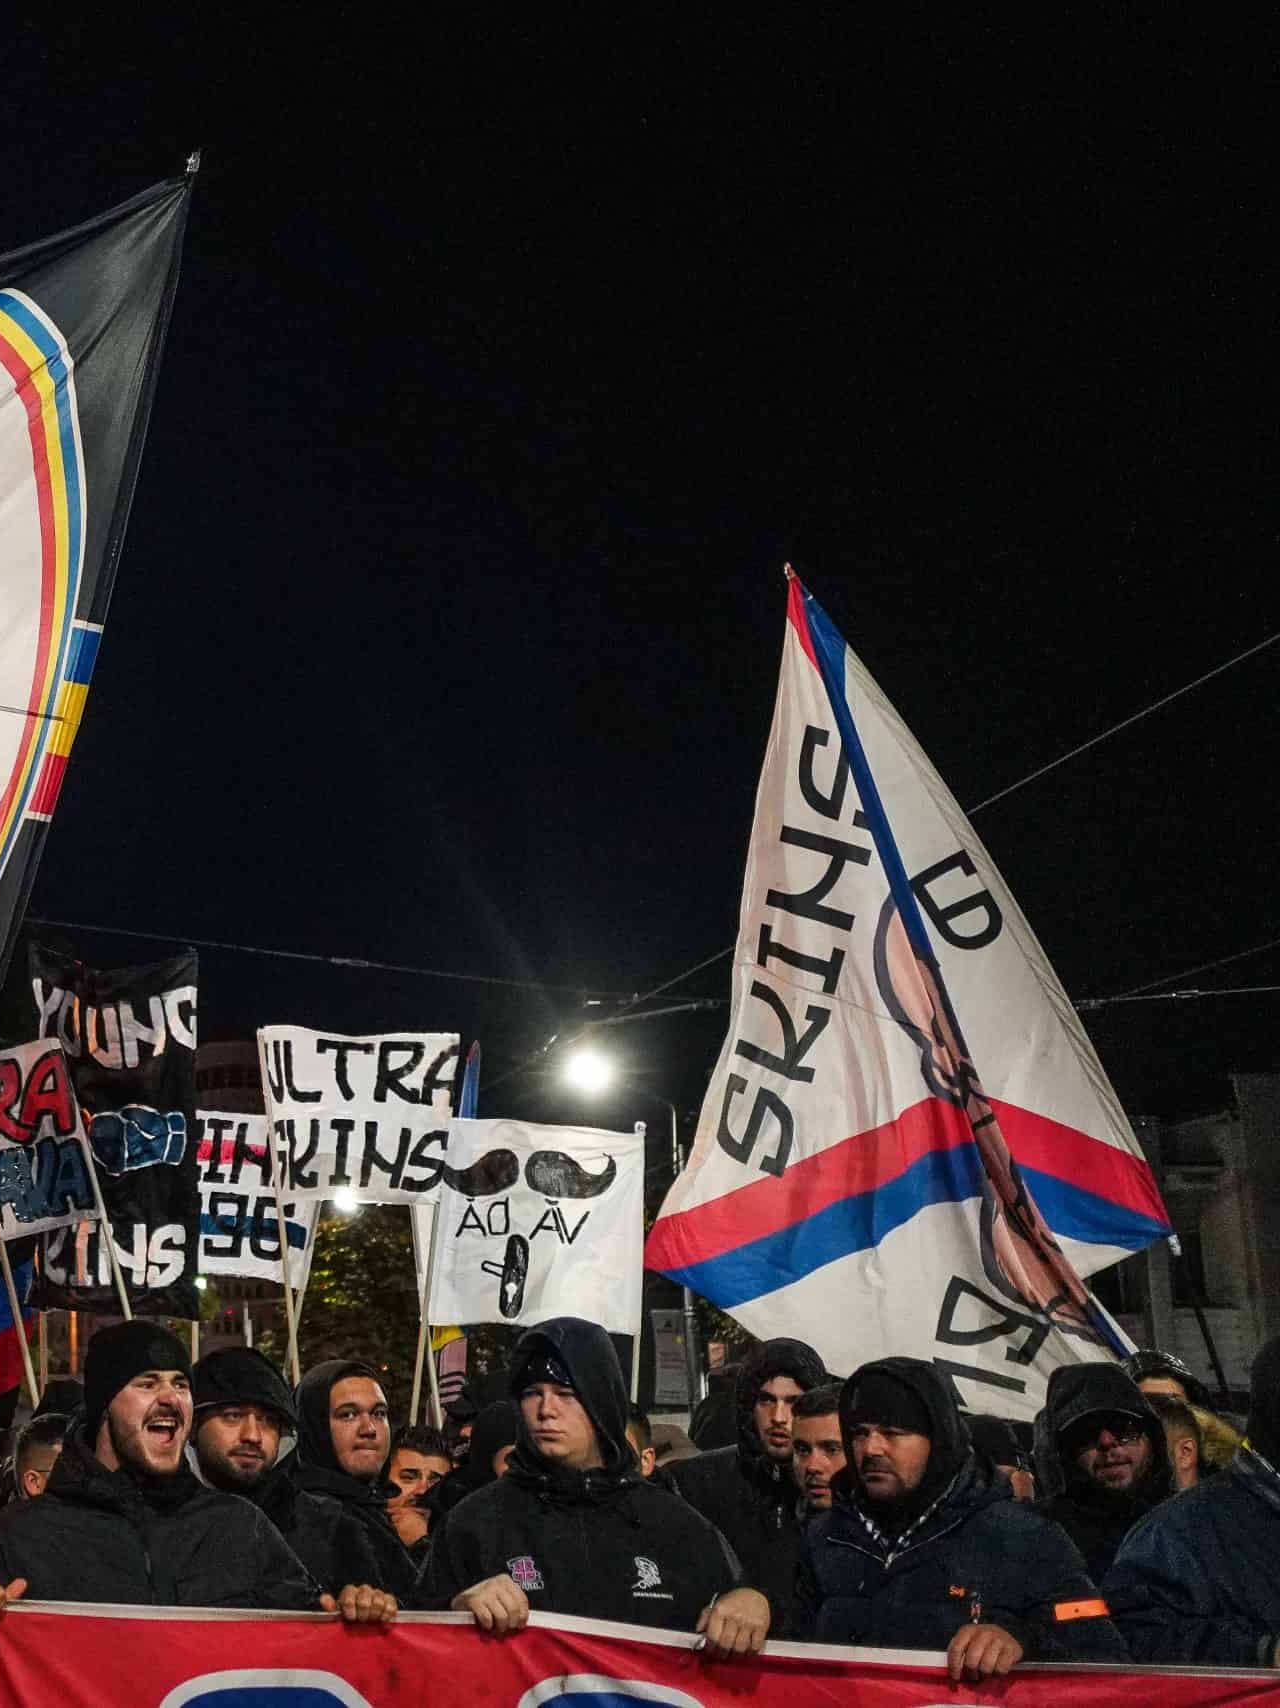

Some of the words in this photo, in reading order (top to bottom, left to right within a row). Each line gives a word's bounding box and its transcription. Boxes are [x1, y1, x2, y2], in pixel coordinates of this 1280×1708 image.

[717, 723, 872, 1177] SKINS
[32, 978, 197, 1069] YOUNG
[264, 1038, 459, 1107] ULTRA
[204, 1191, 296, 1261] 96
